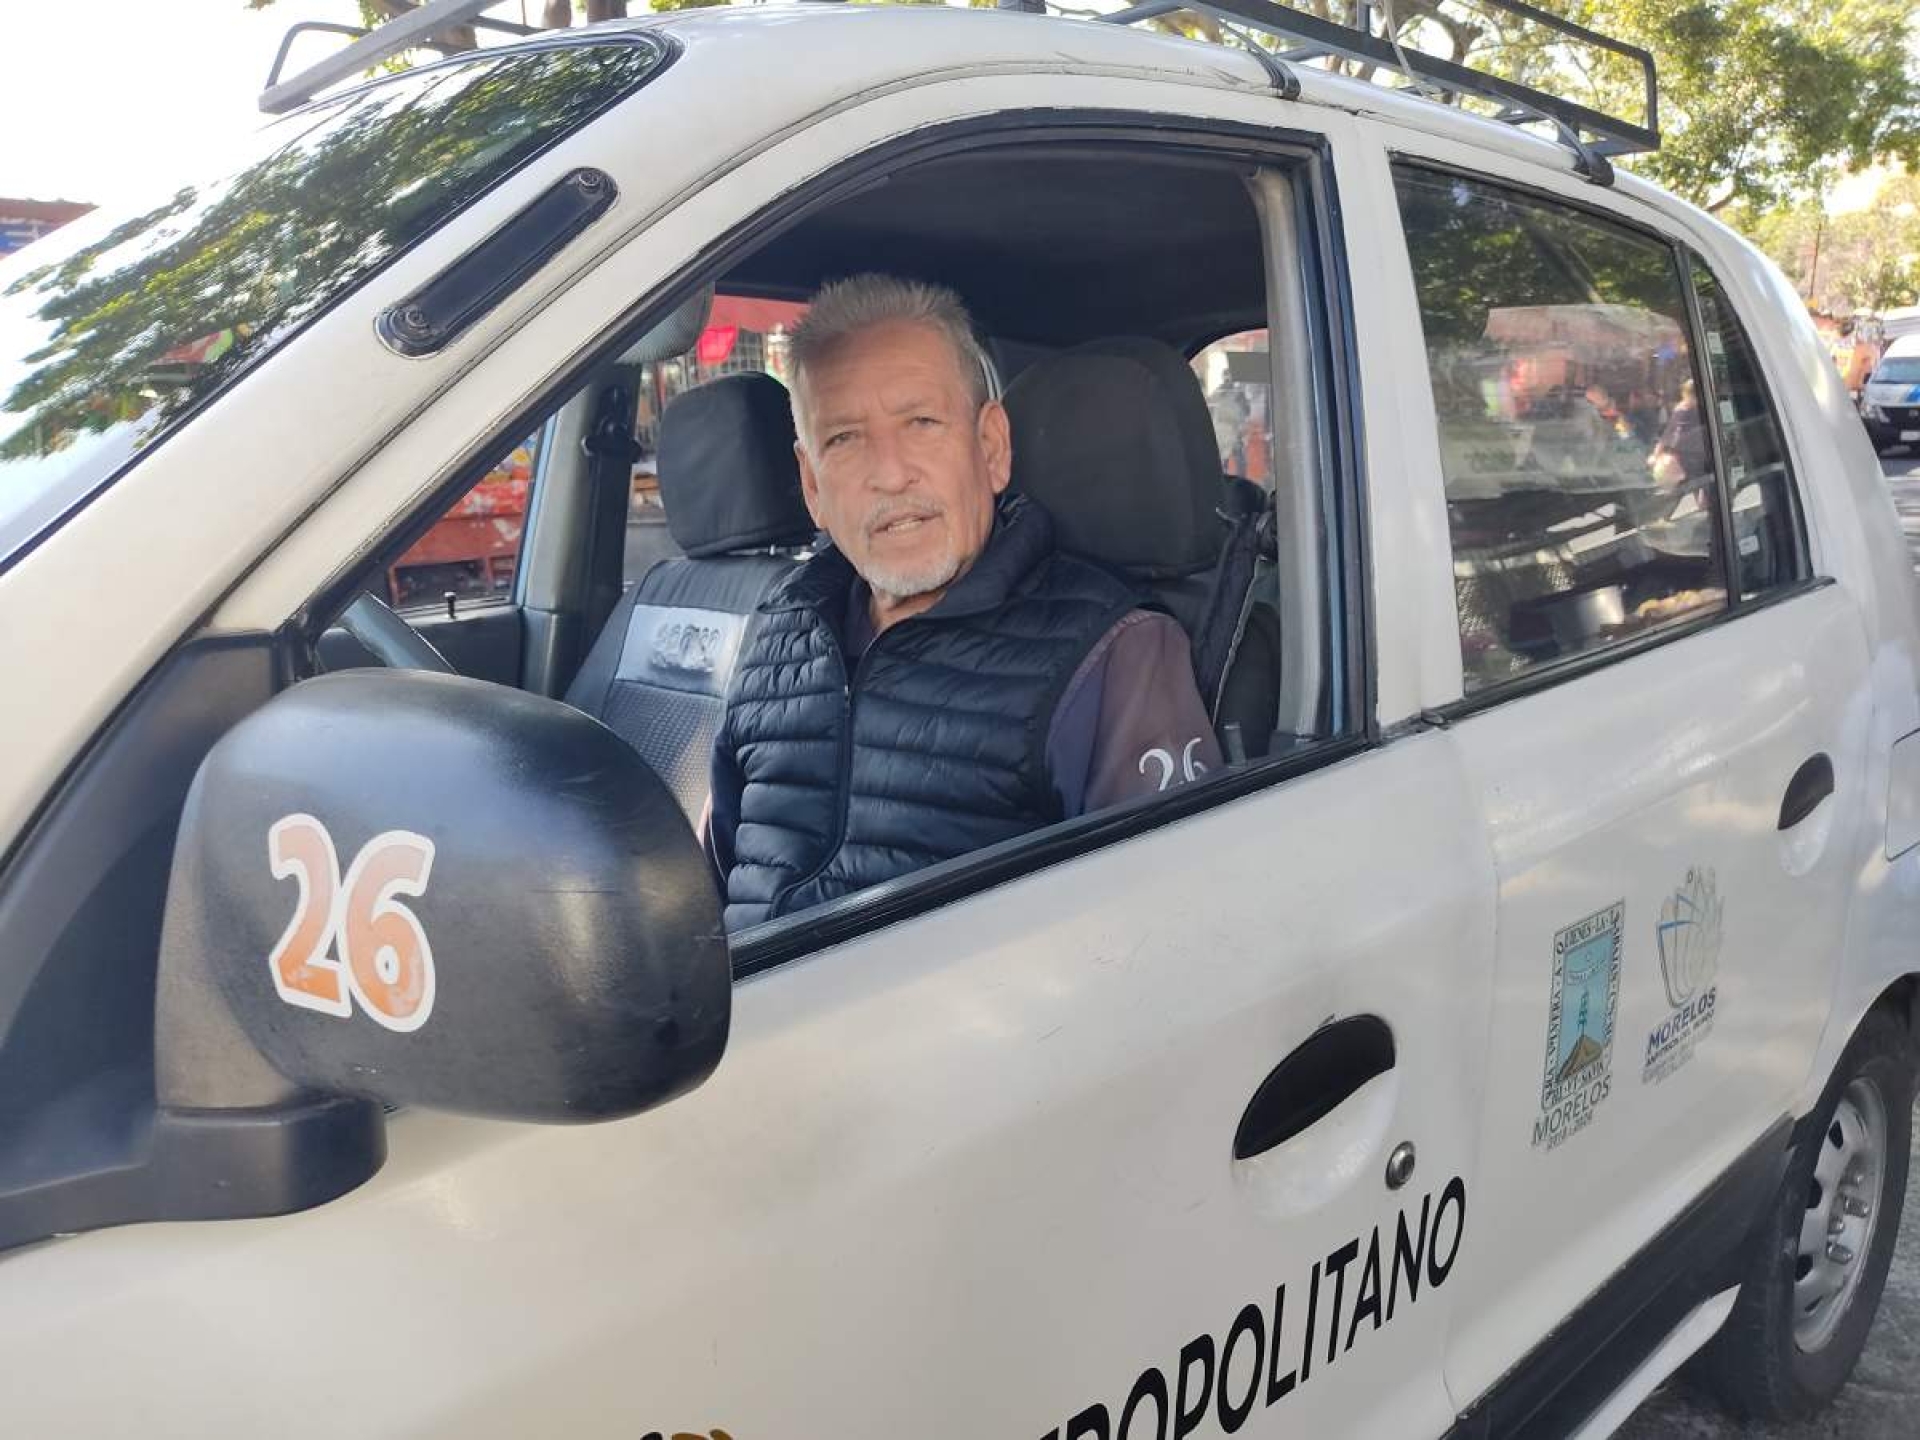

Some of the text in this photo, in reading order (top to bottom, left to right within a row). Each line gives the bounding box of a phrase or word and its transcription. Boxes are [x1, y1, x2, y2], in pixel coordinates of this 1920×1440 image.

[269, 813, 436, 1033] 26
[1647, 985, 1716, 1056] MORELOS
[1531, 1074, 1609, 1146] MORELOS
[1040, 1176, 1465, 1440] OPOLITANO
